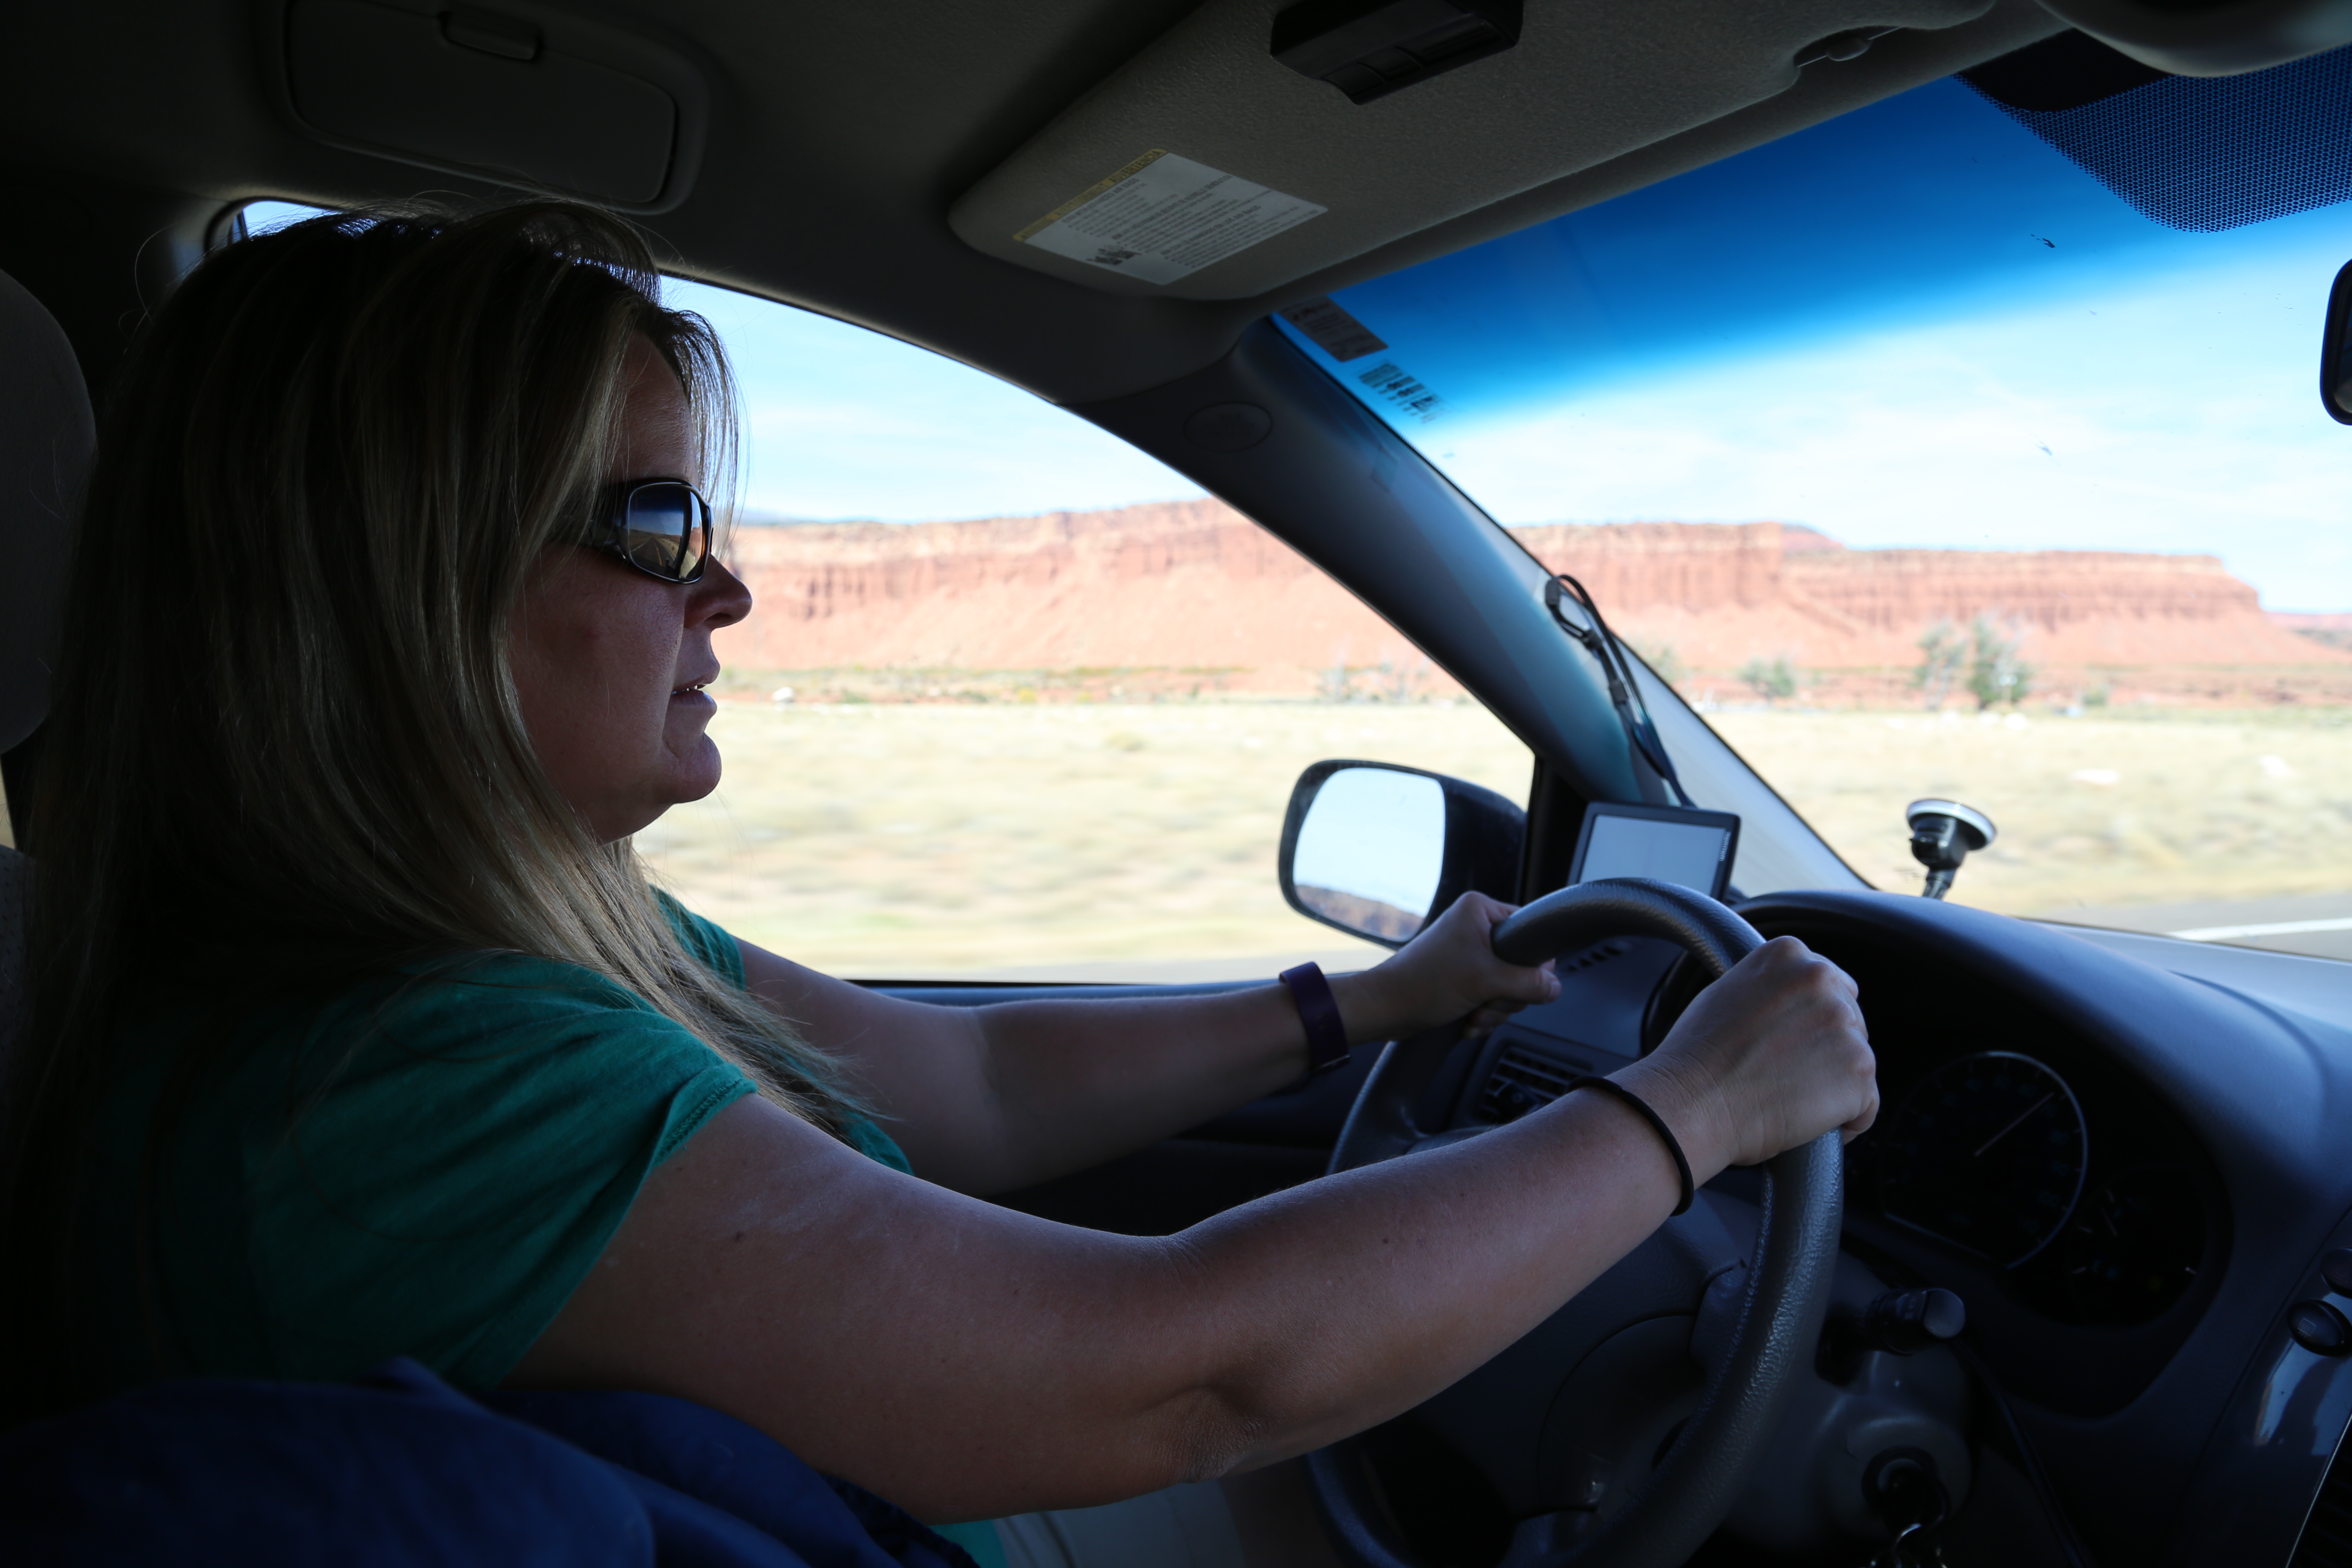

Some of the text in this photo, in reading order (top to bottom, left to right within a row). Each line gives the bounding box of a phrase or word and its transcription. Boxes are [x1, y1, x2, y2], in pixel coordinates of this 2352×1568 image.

[1108, 150, 1162, 183] ADVERTENCIA
[1121, 178, 1139, 188] BAGS
[2049, 1129, 2070, 1146] 80
[2051, 1160, 2070, 1177] 90
[2037, 1189, 2061, 1208] 100
[2017, 1215, 2040, 1235] 110
[2091, 1259, 2103, 1273] E
